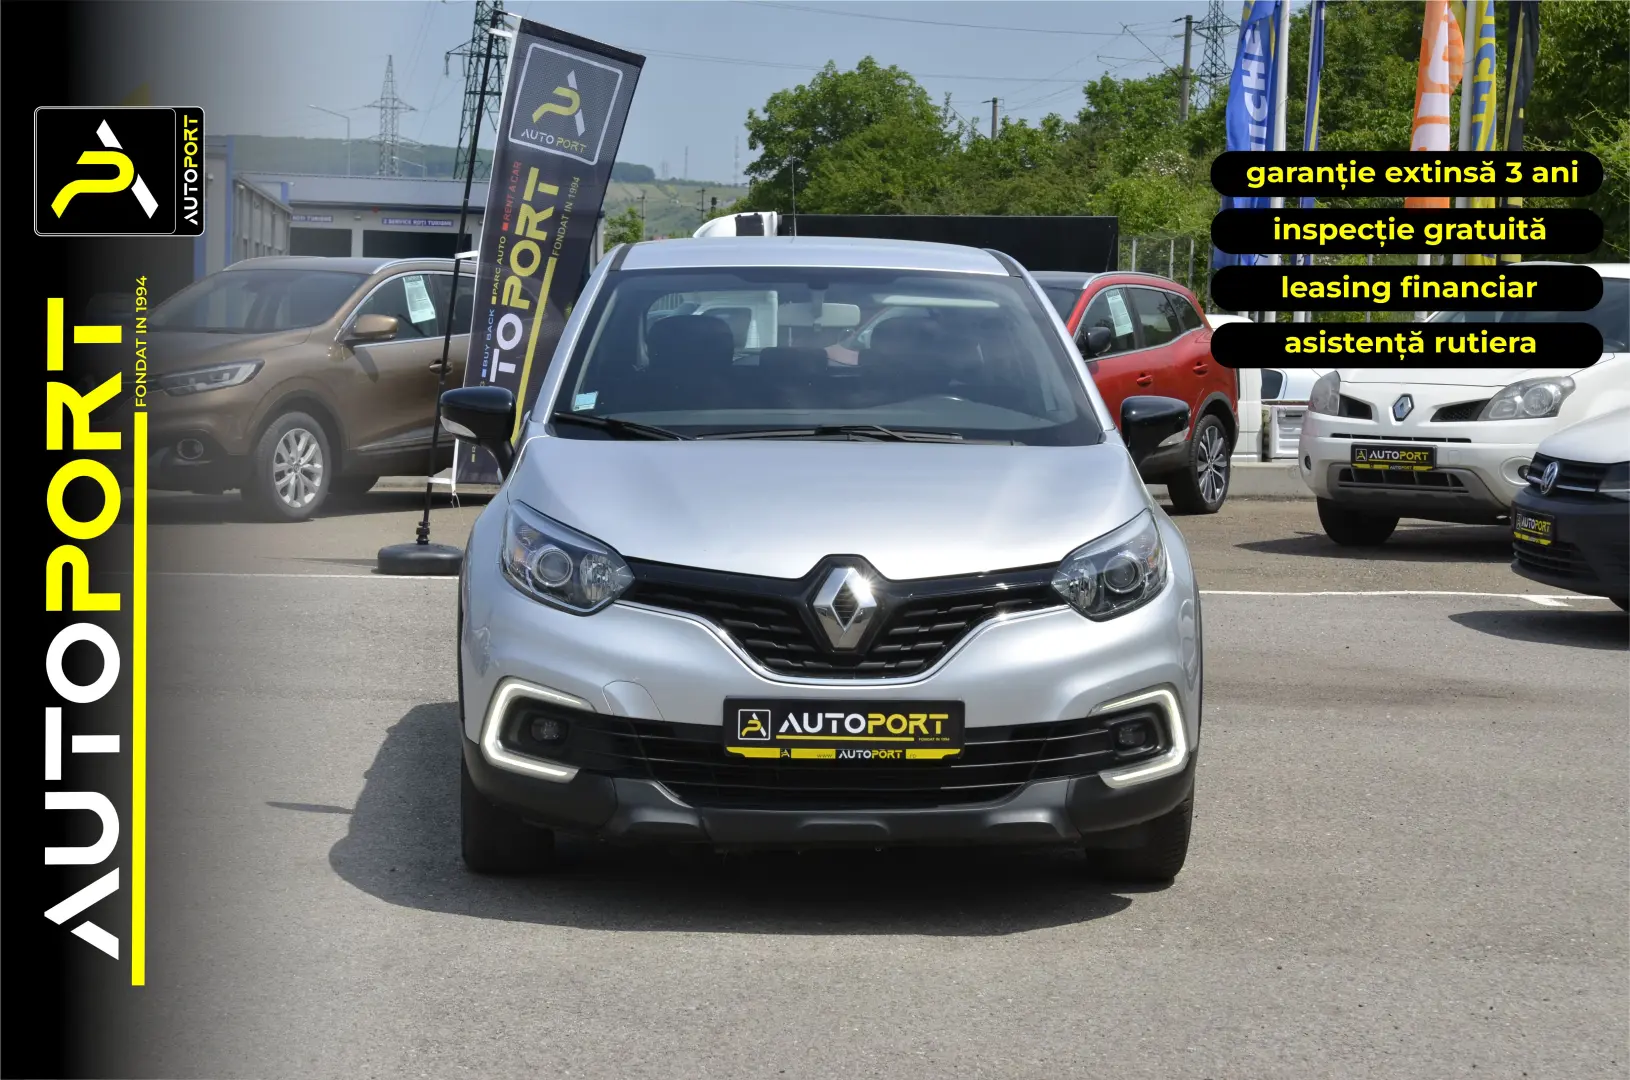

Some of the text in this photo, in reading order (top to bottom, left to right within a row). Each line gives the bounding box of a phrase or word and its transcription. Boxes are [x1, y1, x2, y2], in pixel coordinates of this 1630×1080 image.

[521, 128, 587, 153] AUTO PORT
[503, 161, 522, 221] RENT A CAR
[552, 176, 581, 257] FONDAT IN 1994
[493, 236, 507, 295] PARC AUTO
[482, 308, 495, 368] BUY BACK
[1369, 450, 1429, 461] AUTOPORT
[1521, 516, 1551, 533] AUTOPORT
[778, 712, 949, 735] AUTOPORT
[838, 748, 903, 759] AUTOPORT
